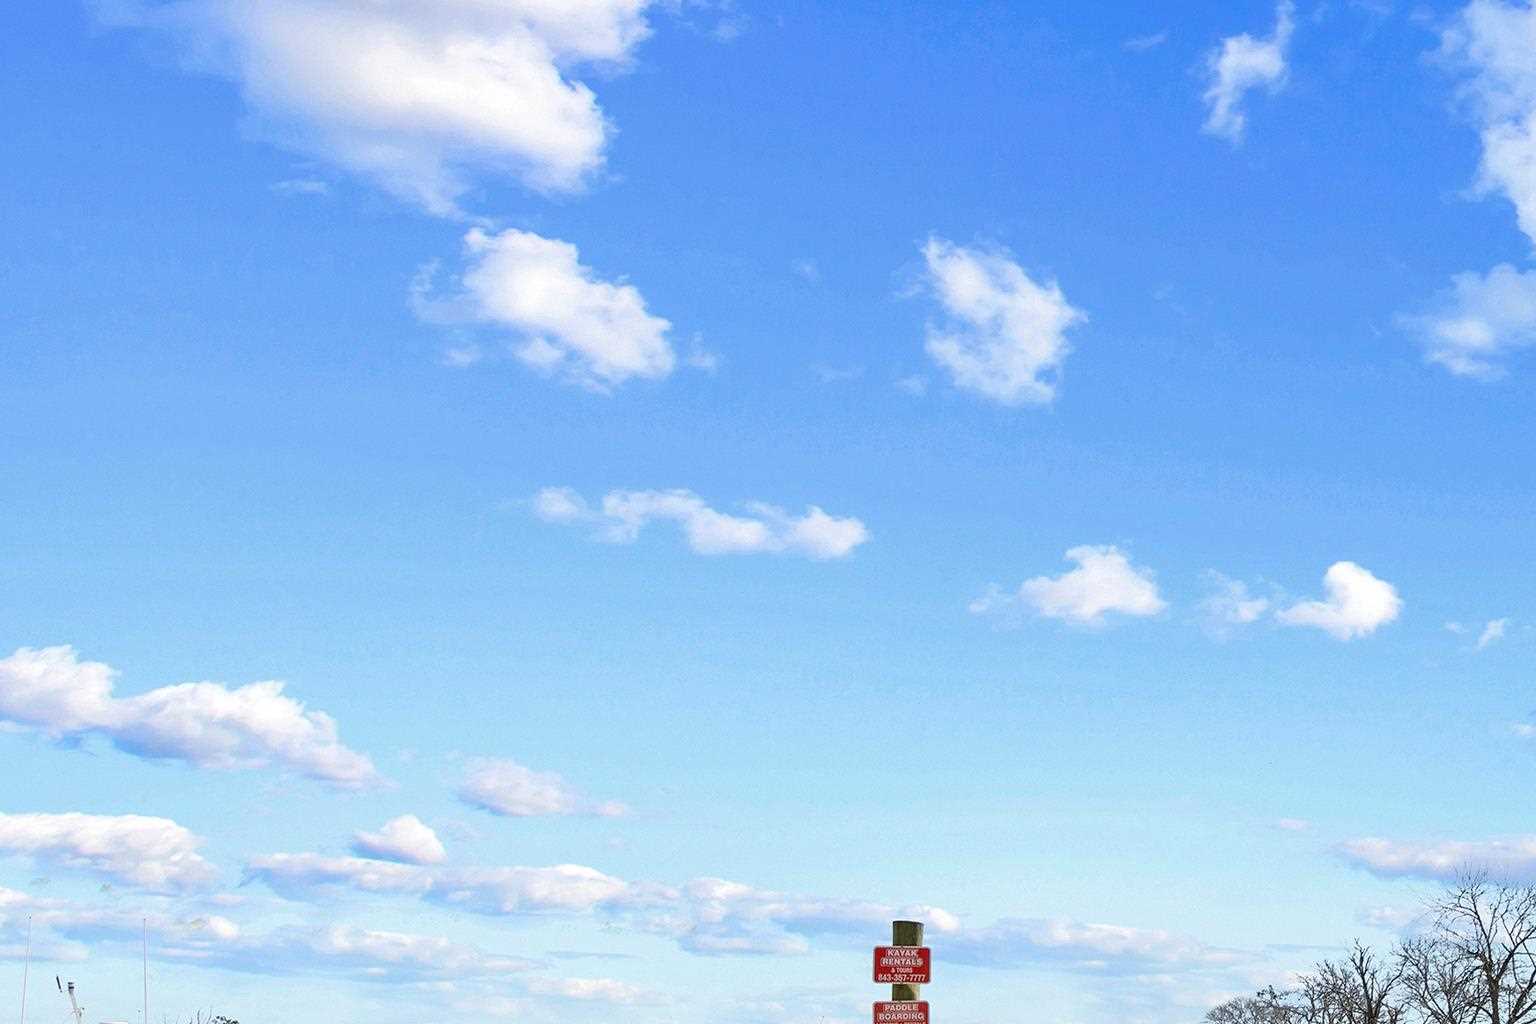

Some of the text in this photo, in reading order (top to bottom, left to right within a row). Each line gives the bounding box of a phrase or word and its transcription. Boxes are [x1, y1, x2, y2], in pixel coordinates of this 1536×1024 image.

[887, 949, 917, 957] KAYAK
[881, 958, 923, 966] RENTALS
[878, 974, 926, 982] 843-357-7777
[884, 1003, 919, 1011] PADDLE
[878, 1012, 925, 1020] BOARDING
